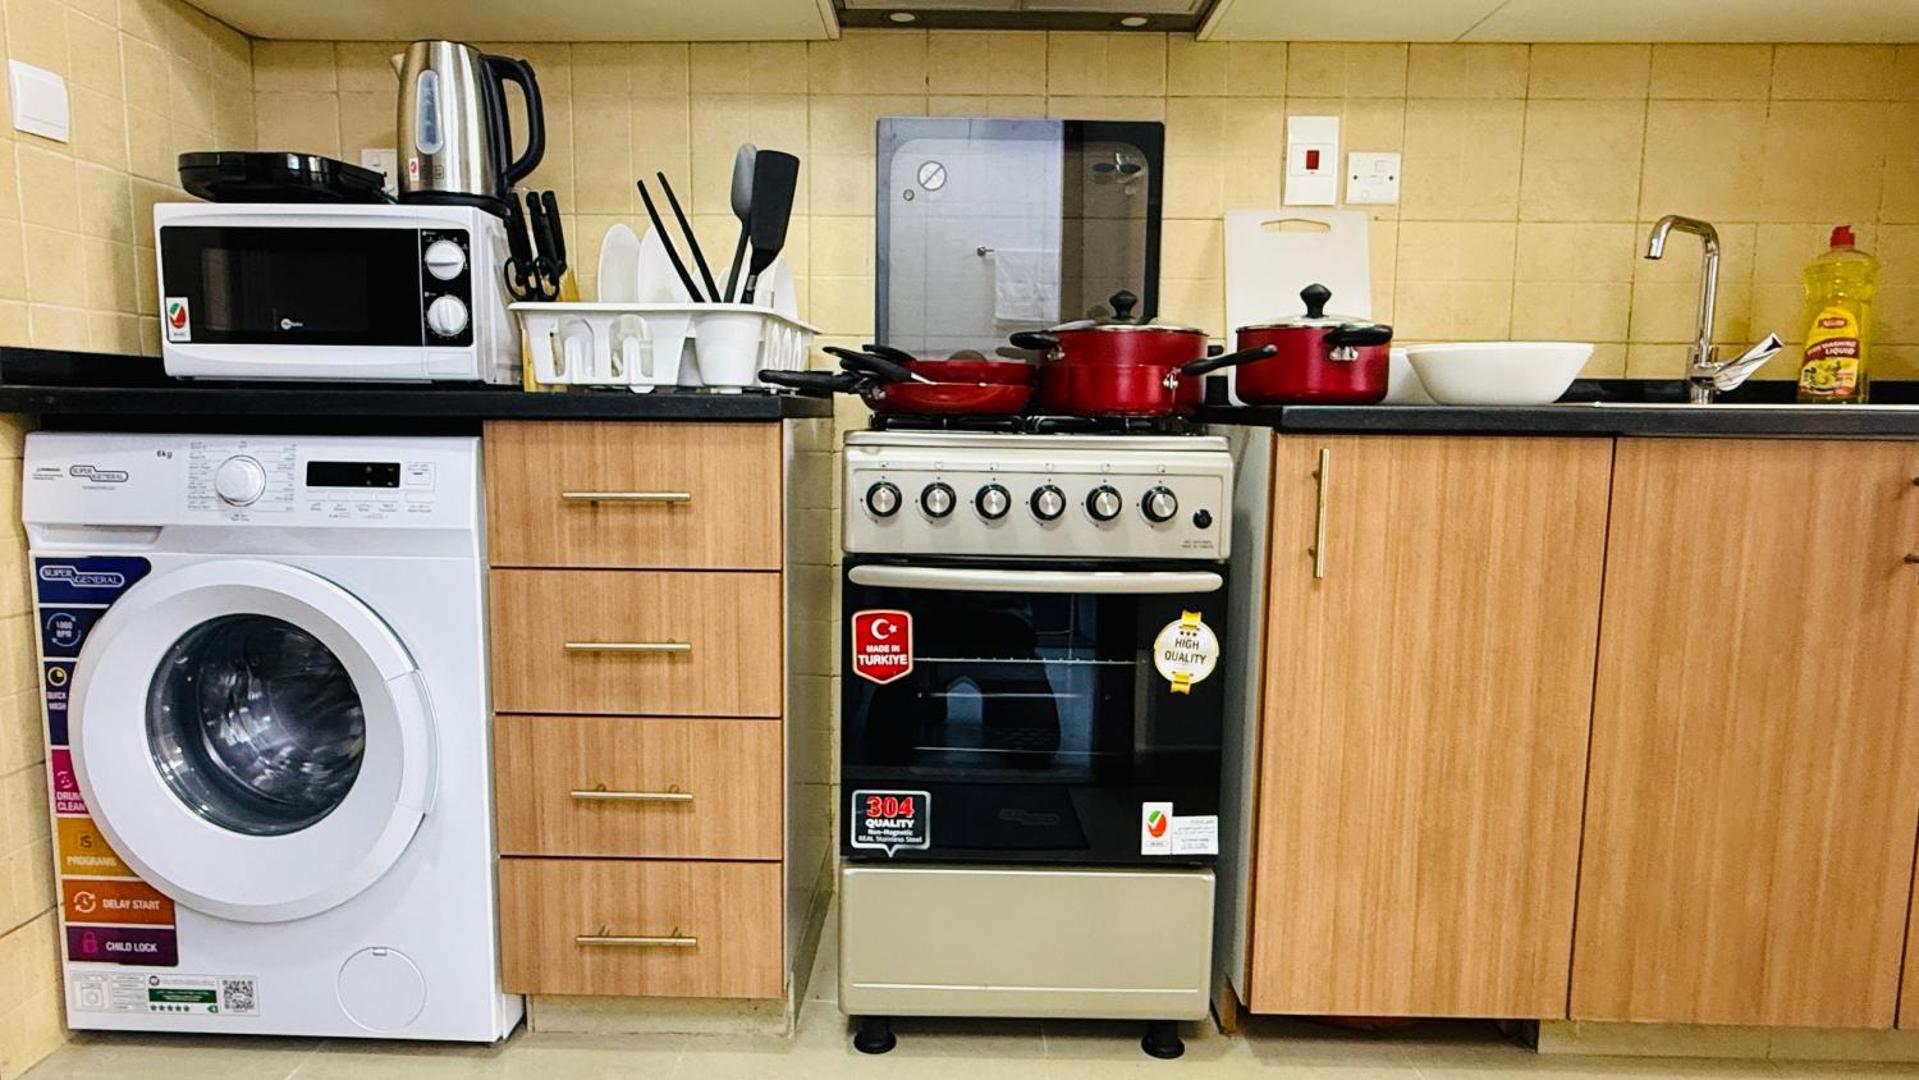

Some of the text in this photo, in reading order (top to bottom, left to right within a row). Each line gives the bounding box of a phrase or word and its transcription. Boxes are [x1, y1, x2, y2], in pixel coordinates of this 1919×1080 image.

[1825, 347, 1856, 355] LIQUID
[44, 568, 118, 584] SUPER GENERAL
[866, 644, 900, 653] MADE IN
[1175, 638, 1200, 650] HIGH
[1164, 650, 1207, 664] QUALITY
[57, 801, 85, 812] CLEAN
[866, 796, 915, 818] 304
[865, 819, 914, 829] QUALITY
[103, 898, 160, 910] DELAY START
[105, 941, 158, 952] CHILD LOCK
